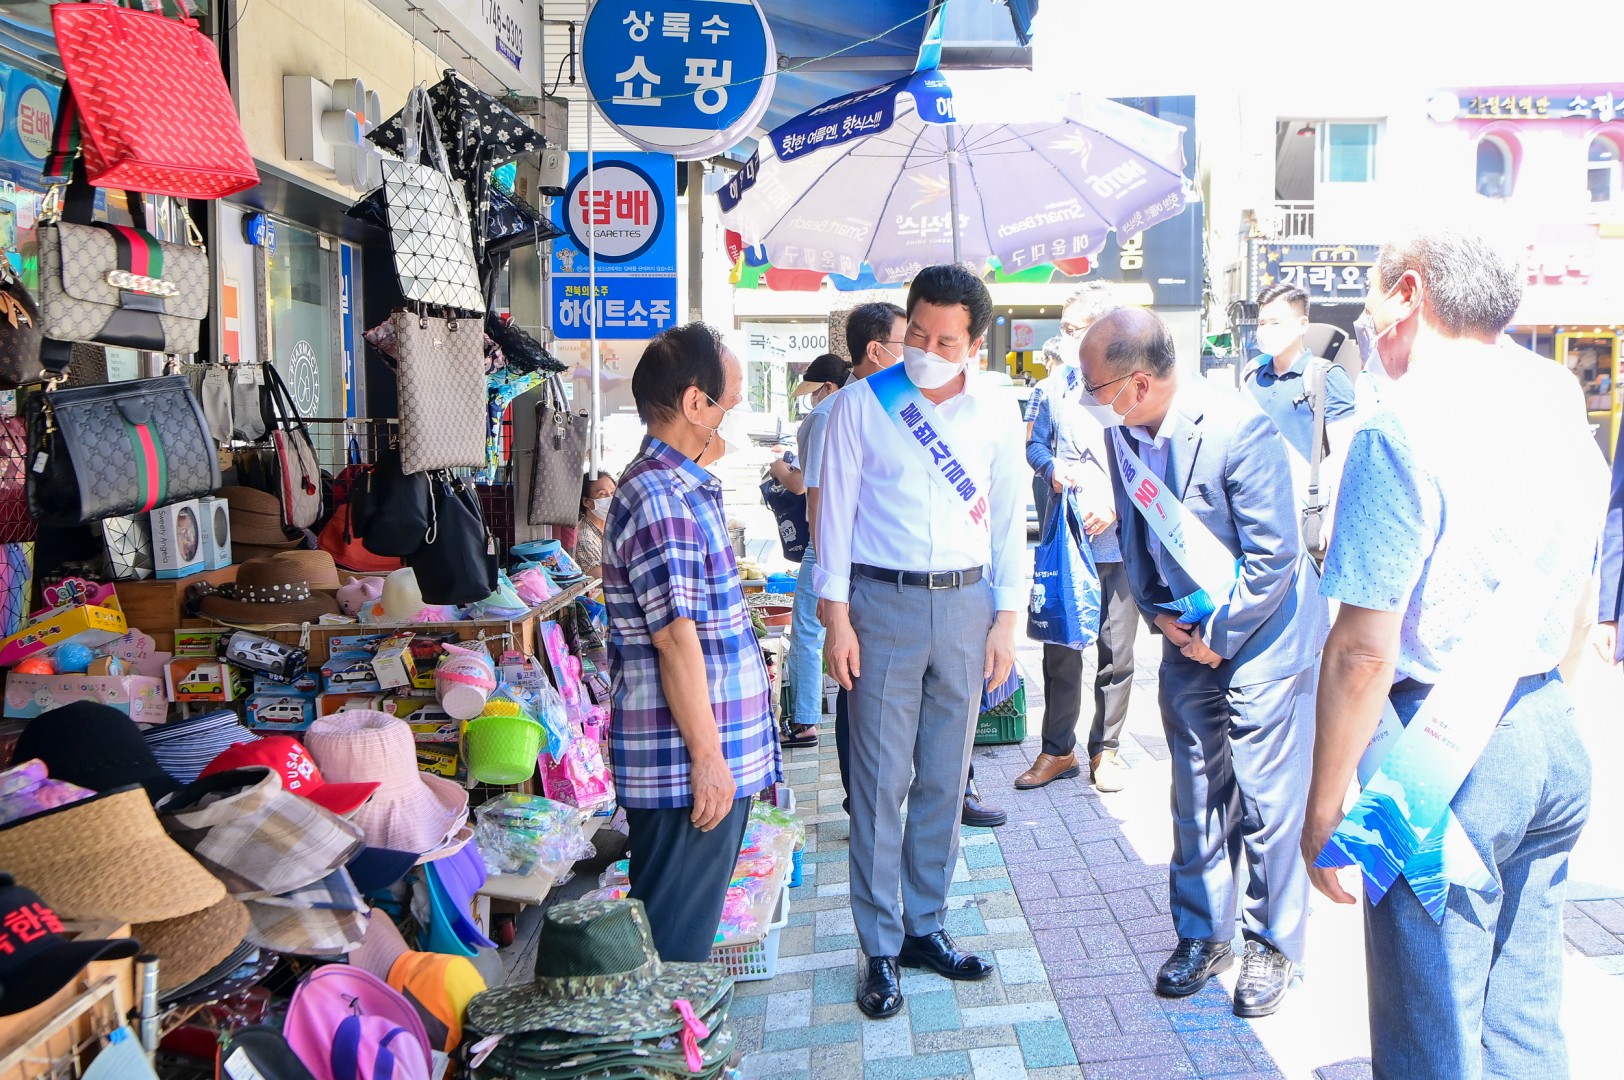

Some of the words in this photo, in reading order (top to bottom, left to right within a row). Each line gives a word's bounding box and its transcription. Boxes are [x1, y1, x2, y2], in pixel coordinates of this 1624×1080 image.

[623, 10, 730, 44] 상록수
[612, 56, 732, 114] 쇼핑
[1561, 92, 1624, 122] 소정
[20, 104, 50, 140] 담배
[782, 135, 805, 155] 핫한
[579, 190, 648, 225] 담배
[586, 230, 641, 238] CGARETTES
[565, 285, 590, 297] 전북의
[1280, 266, 1371, 292] 가락오
[559, 299, 671, 328] 하이트소주
[788, 335, 827, 351] 3,000
[158, 511, 166, 535] Sweety
[782, 526, 794, 537] 397
[160, 537, 168, 564] Angela
